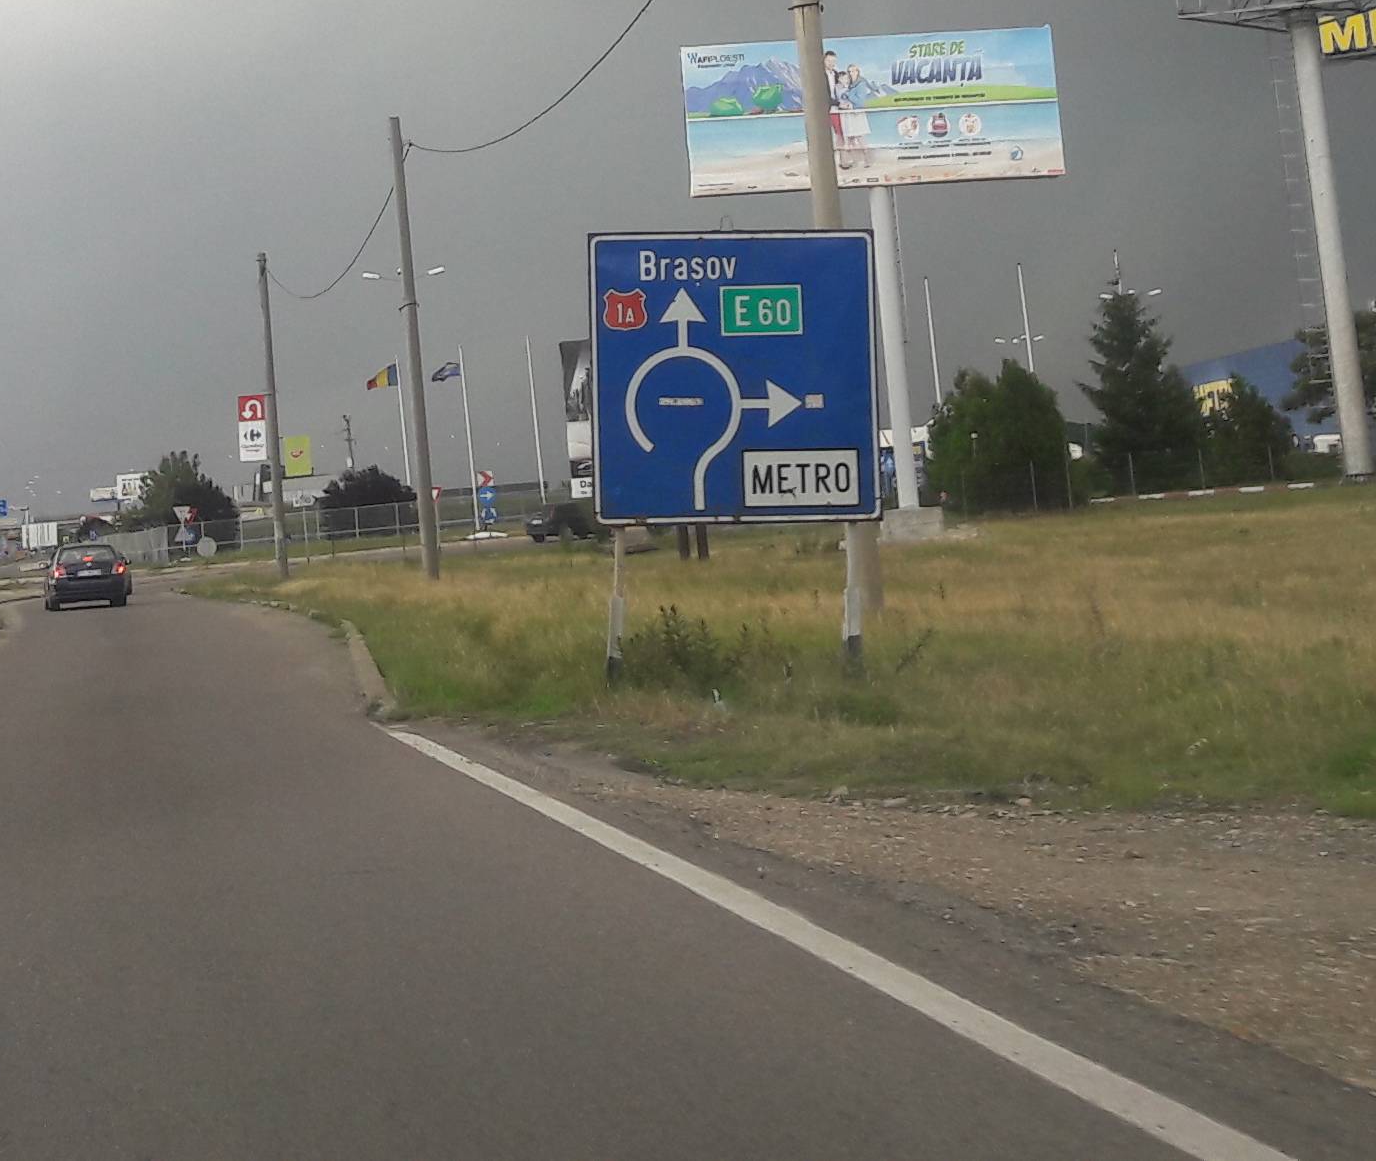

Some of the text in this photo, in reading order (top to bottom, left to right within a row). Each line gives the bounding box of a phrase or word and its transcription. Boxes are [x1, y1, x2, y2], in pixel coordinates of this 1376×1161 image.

[909, 41, 965, 58] STARE DE
[734, 295, 792, 327] E 60
[751, 462, 851, 495] METRO
